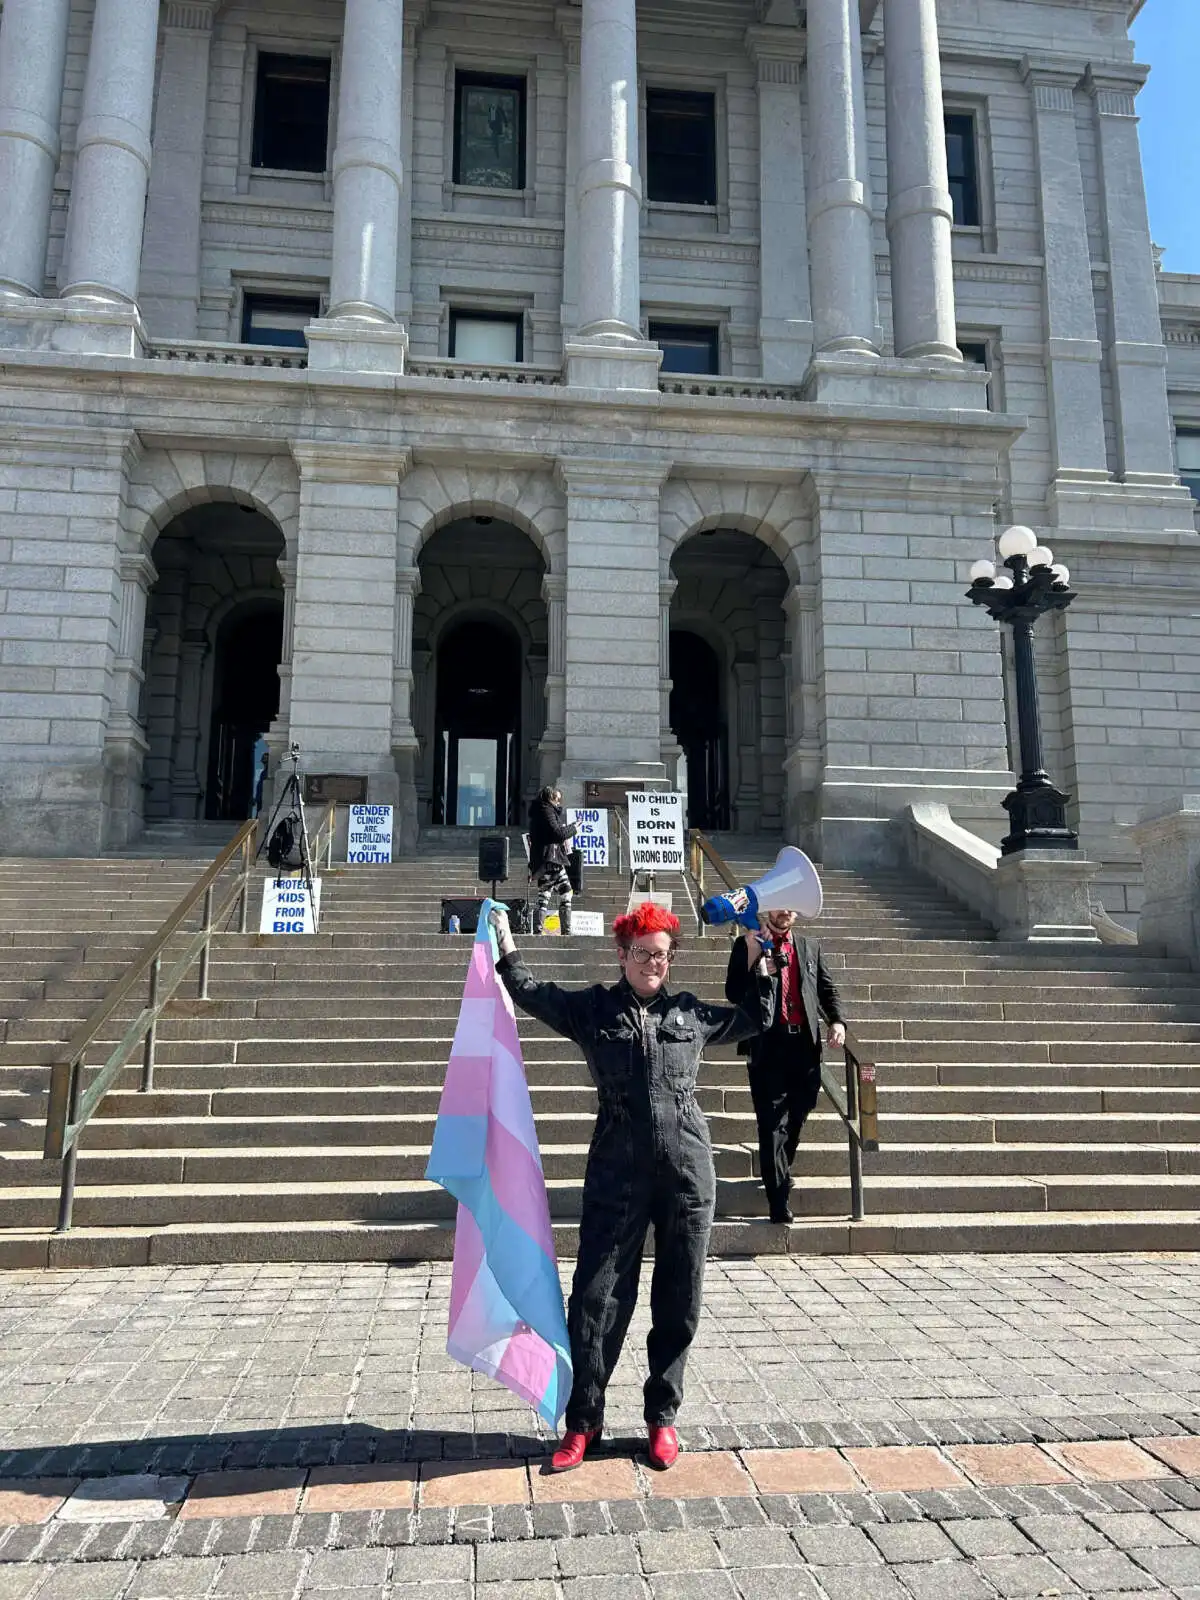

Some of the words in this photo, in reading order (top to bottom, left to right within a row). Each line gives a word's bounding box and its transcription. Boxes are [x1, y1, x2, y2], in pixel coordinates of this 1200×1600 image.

[632, 794, 645, 803] NO
[649, 796, 677, 804] CHILD
[352, 805, 390, 816] GENDER
[650, 808, 660, 816] IS
[357, 816, 385, 824] CLINICS
[575, 810, 599, 822] WHO
[582, 825, 594, 833] IS
[637, 820, 675, 829] BORN
[351, 833, 390, 843] STERILIZING
[573, 835, 605, 848] KEIRA
[637, 836, 649, 844] IN
[652, 836, 676, 844] THE
[349, 851, 389, 863] YOUTH
[583, 850, 606, 864] ELL?
[633, 850, 661, 863] WRONG
[663, 851, 682, 863] BODY
[277, 893, 305, 902] KIDS
[275, 907, 305, 917] FROM
[273, 921, 304, 933] BIG
